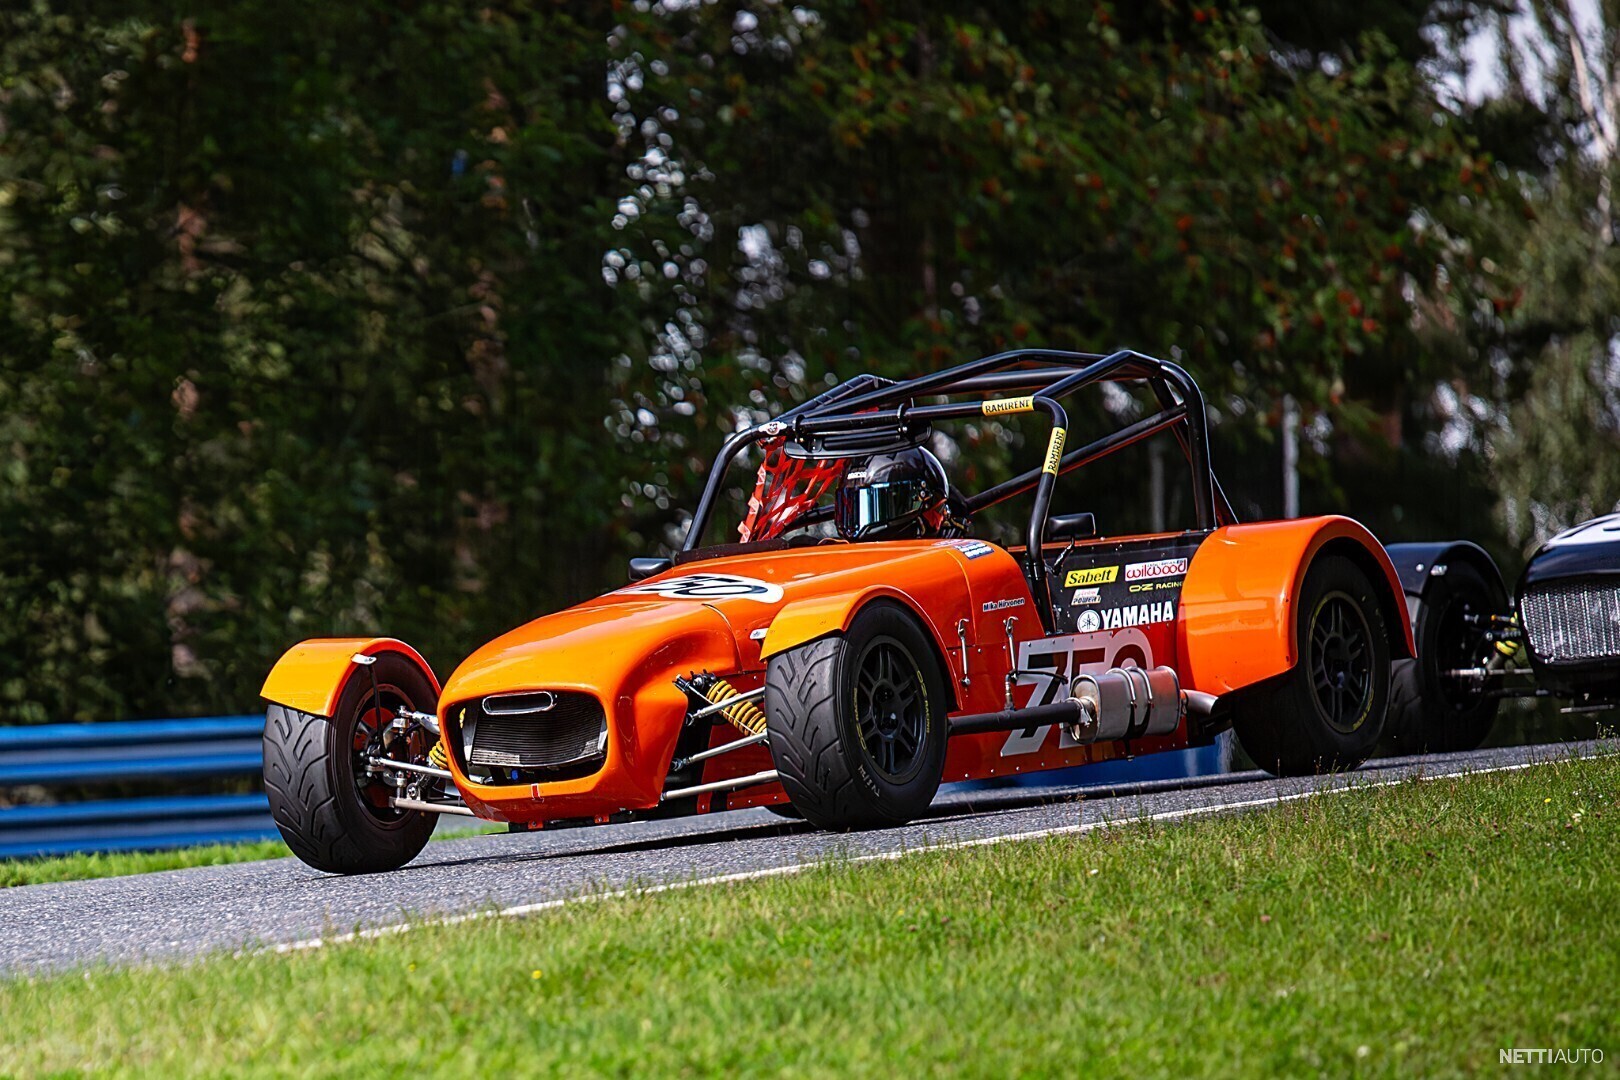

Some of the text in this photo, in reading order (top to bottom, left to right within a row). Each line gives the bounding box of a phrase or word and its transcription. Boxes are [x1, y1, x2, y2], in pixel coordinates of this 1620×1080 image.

[984, 399, 1031, 413] RAMIRENT
[1047, 431, 1065, 472] RAMIRENT
[1068, 569, 1112, 585] Sabelt
[1126, 559, 1187, 579] wilwood
[983, 597, 1026, 612] Mika Hirvonen
[1100, 600, 1174, 631] YAMAHA
